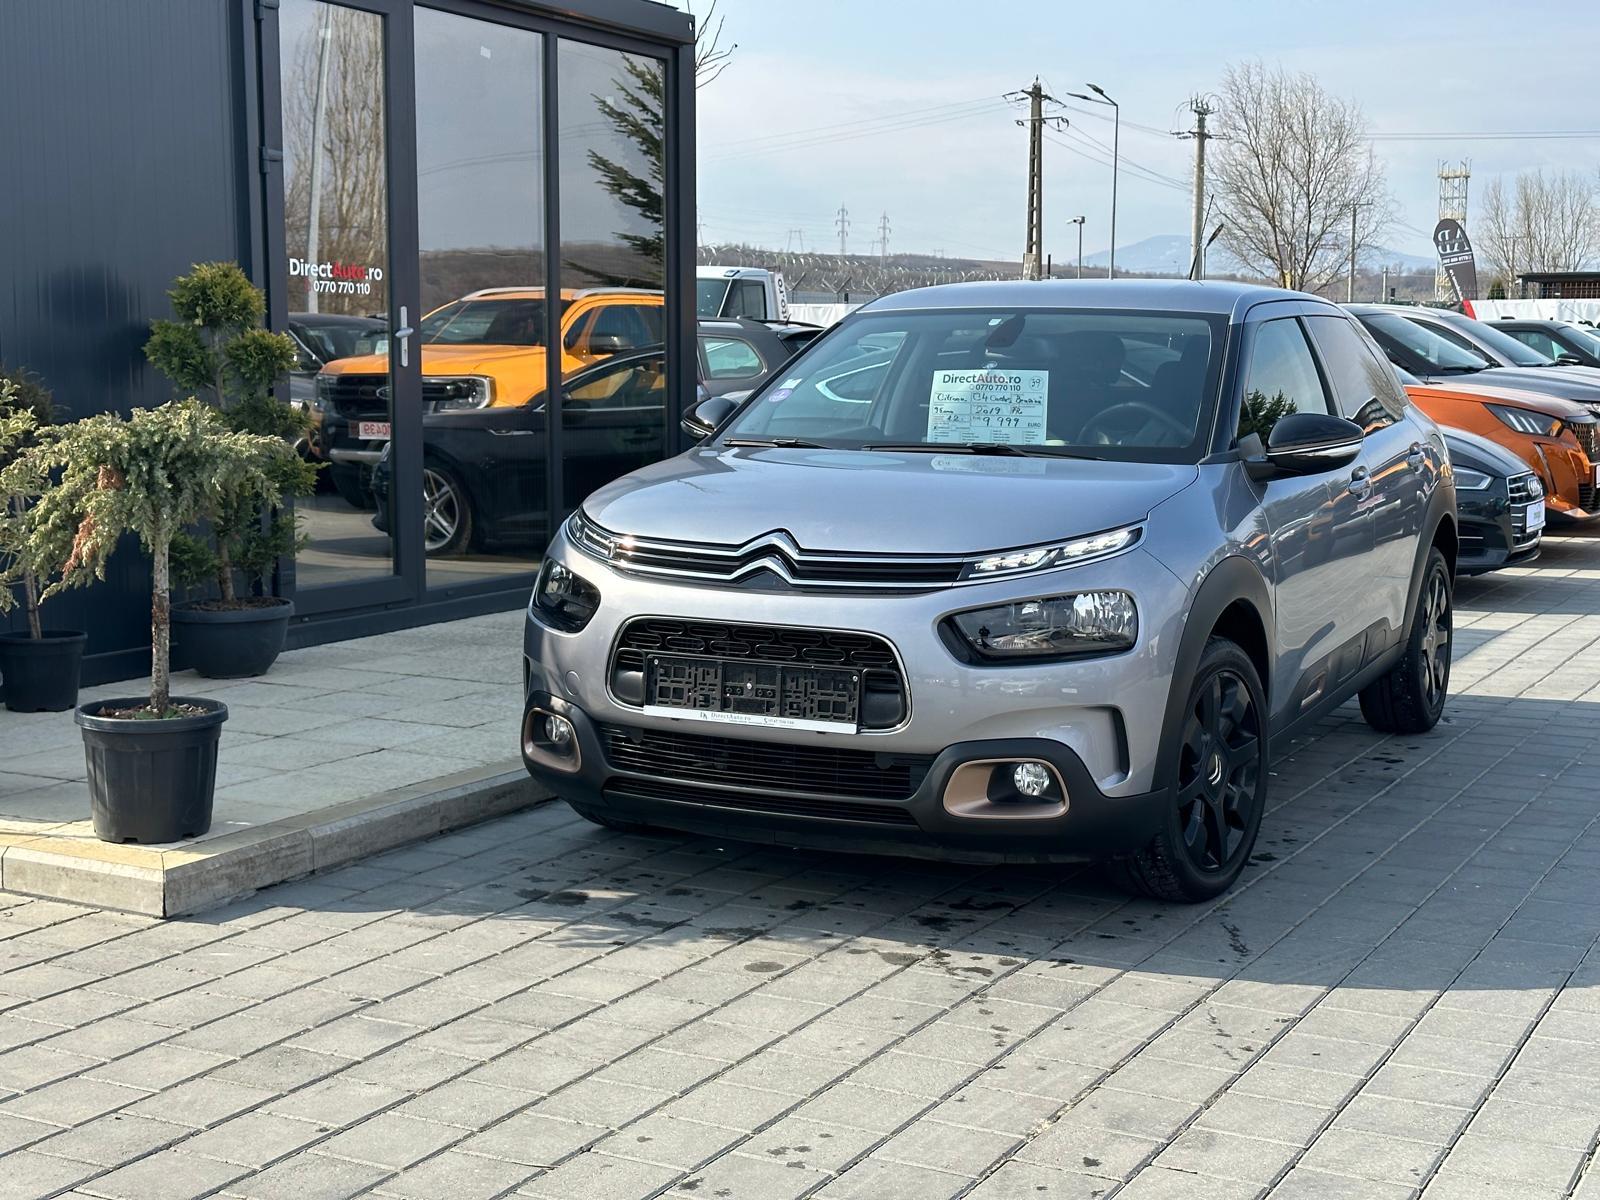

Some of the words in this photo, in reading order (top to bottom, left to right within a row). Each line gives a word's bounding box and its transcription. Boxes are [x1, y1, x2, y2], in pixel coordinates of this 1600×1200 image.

[289, 258, 383, 281] DirectAuto.ro
[313, 280, 337, 293] 0770
[338, 281, 355, 294] 770
[356, 283, 371, 295] 110
[942, 373, 1022, 384] DirectAuto.ro
[975, 406, 1001, 415] 2019
